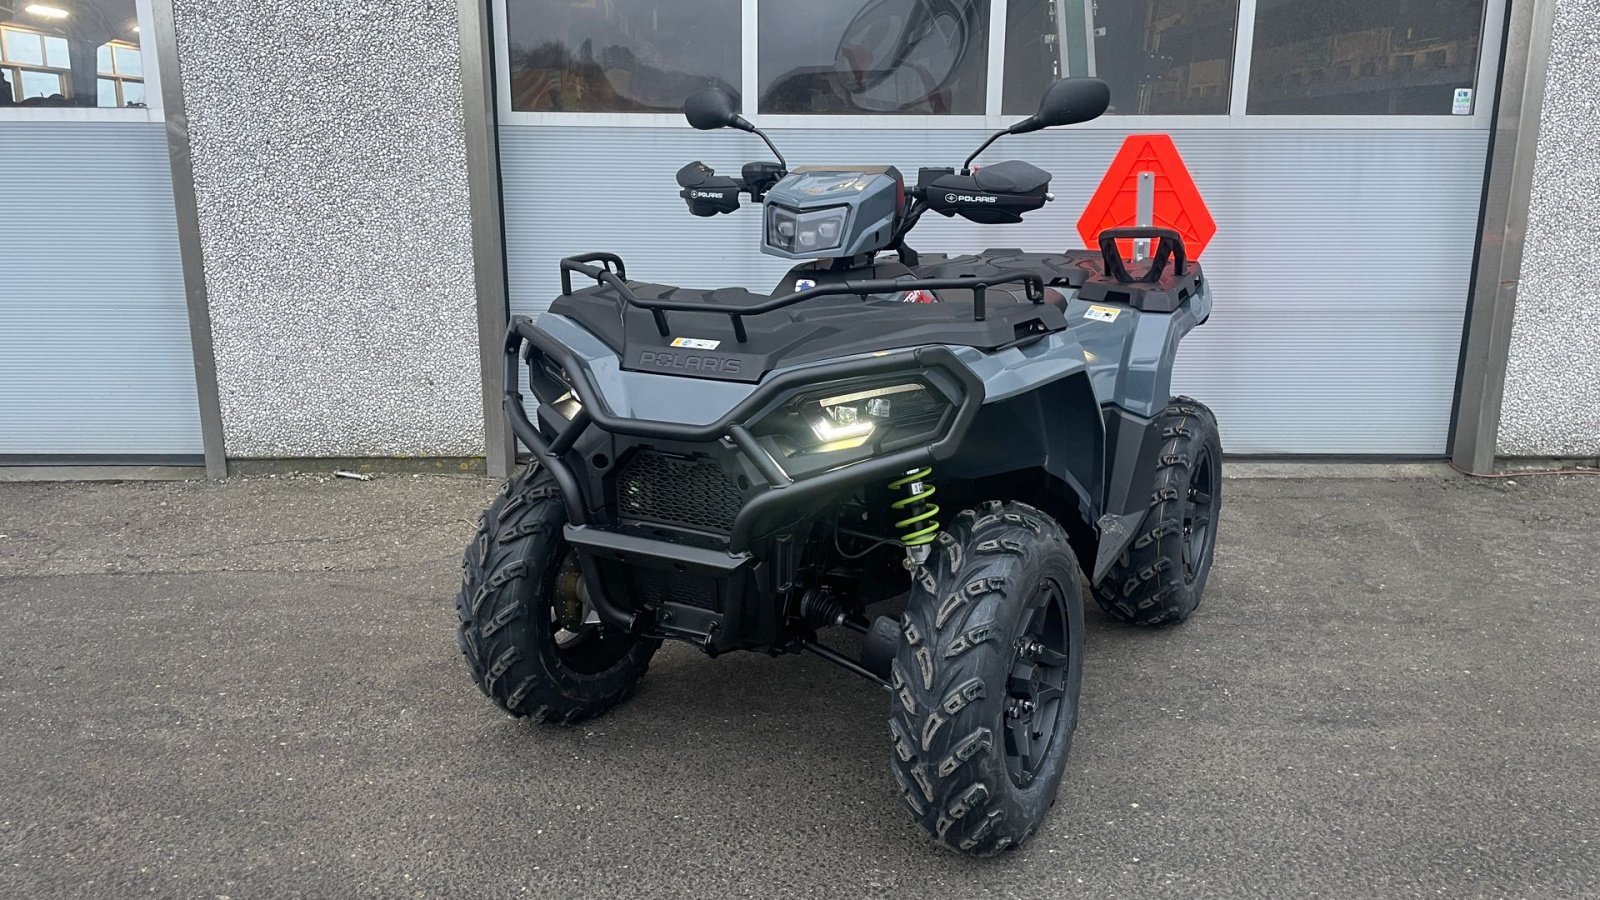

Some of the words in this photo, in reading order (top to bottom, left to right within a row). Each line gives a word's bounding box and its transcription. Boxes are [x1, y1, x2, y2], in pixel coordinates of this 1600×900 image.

[698, 191, 723, 199] POLARIS
[958, 195, 996, 203] POLARIS
[640, 351, 742, 374] POLARIS
